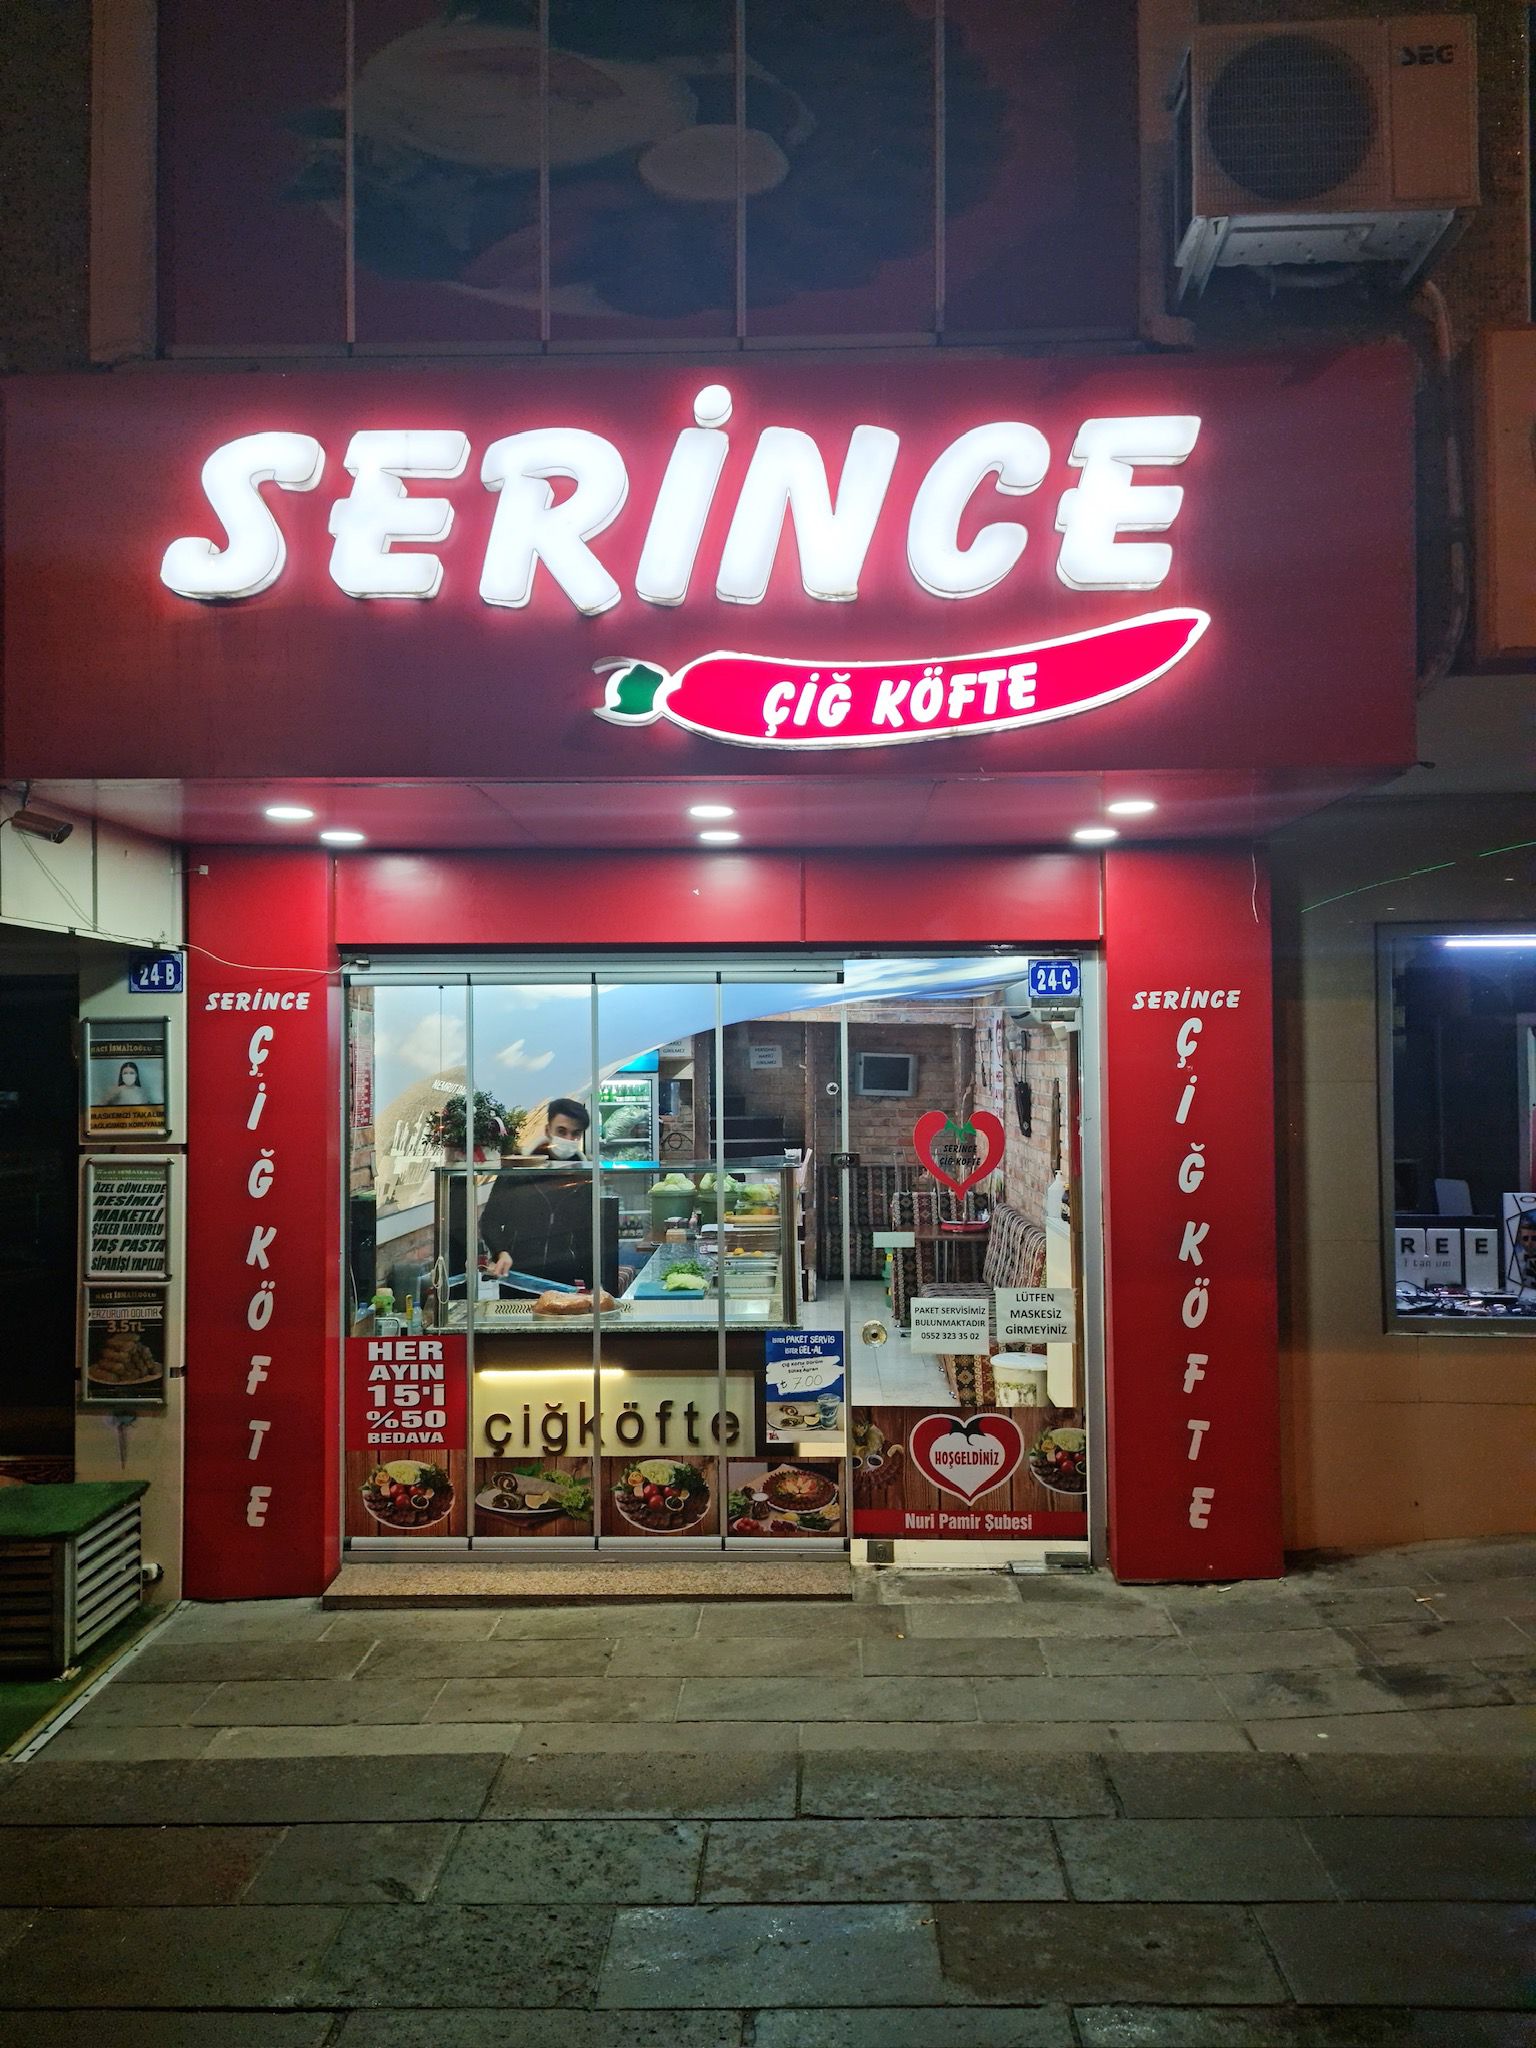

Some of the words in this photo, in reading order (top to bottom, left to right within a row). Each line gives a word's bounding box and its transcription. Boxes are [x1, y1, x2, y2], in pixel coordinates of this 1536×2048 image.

[1401, 44, 1454, 66] SEG
[159, 383, 1203, 617] SERİNCE
[762, 672, 852, 737] ÇİĞ
[872, 662, 1038, 728] KÖFTE
[139, 962, 176, 987] 24-B
[1037, 968, 1072, 991] 24-C
[205, 987, 311, 1012] SERİNCE
[1132, 985, 1242, 1012] SERİNCE
[93, 1182, 116, 1194] ÖZEL
[116, 1182, 167, 1194] GÜNLERDE
[93, 1195, 164, 1207] RESİMLİ
[93, 1208, 164, 1223] MAKETLİ
[92, 1239, 118, 1254] YAŞ
[119, 1239, 166, 1253] PASTA
[1016, 1291, 1055, 1302] LÜTFEN
[914, 1307, 939, 1315] PAKET
[941, 1306, 986, 1315] SERVİSİMİZ
[1010, 1309, 1062, 1319] MASKESİZ
[915, 1319, 986, 1327] BULUNMAKTADIR
[1005, 1325, 1067, 1335] GİRMEYİNİZ
[786, 1335, 808, 1344] PAKET
[921, 1332, 941, 1340] 0552
[942, 1332, 957, 1340] 323
[958, 1332, 968, 1340] 35
[969, 1332, 980, 1340] 02
[368, 1341, 443, 1361] HER
[368, 1364, 444, 1380] AYIN
[366, 1410, 446, 1429] %50
[485, 1400, 740, 1457] çiğköfte
[368, 1432, 444, 1443] BEDAVA
[935, 1449, 999, 1469] HOŞGELDİNİZ
[905, 1513, 935, 1529] Nuri
[939, 1513, 980, 1530] Pamir
[985, 1514, 1032, 1531] Şubesi
